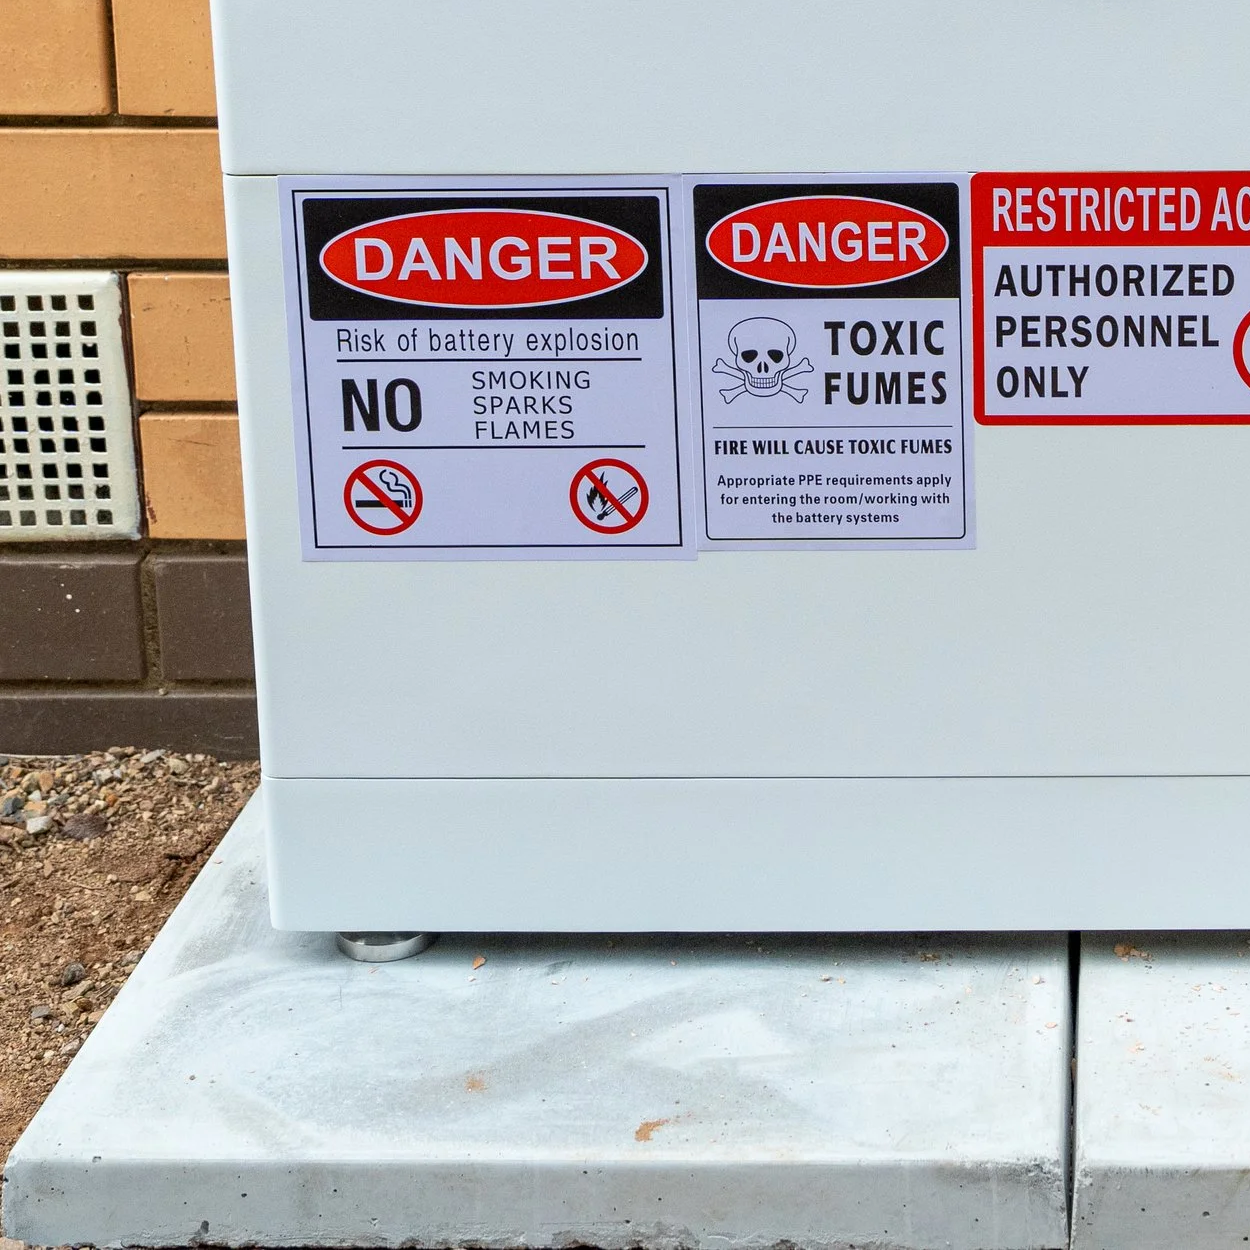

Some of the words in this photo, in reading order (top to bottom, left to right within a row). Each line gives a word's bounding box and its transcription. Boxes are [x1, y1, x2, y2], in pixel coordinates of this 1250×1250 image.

[993, 187, 1200, 231] RESTRICTED
[732, 222, 928, 262] DANGER
[354, 236, 621, 281] DANGER
[995, 264, 1234, 297] AUTHORIZED
[337, 328, 384, 352] Risk
[398, 328, 417, 352] of
[430, 328, 513, 357] battery
[527, 328, 638, 357] explosion
[824, 320, 943, 355] TOXIC
[996, 315, 1219, 347] PERSONNEL
[473, 371, 589, 389] SMOKING
[825, 371, 946, 405] FUMES
[997, 366, 1088, 398] ONLY
[342, 378, 422, 432] NO
[474, 396, 572, 414] SPARKS
[476, 421, 574, 439] FLAMES
[715, 441, 747, 454] FIRE
[753, 440, 789, 454] WILL
[794, 440, 843, 454] CAUSE
[849, 440, 895, 454] TOXIC
[901, 439, 952, 454] FUMES
[718, 475, 795, 488] Appropriate
[799, 475, 822, 485] PPE
[827, 475, 912, 487] requirements
[917, 474, 951, 487] apply
[721, 494, 738, 504] for
[743, 494, 796, 507] entering
[801, 494, 820, 504] the
[825, 493, 917, 506] room/working
[921, 493, 949, 503] with
[772, 512, 792, 523] the
[796, 513, 842, 524] battery
[847, 514, 899, 525] systems
